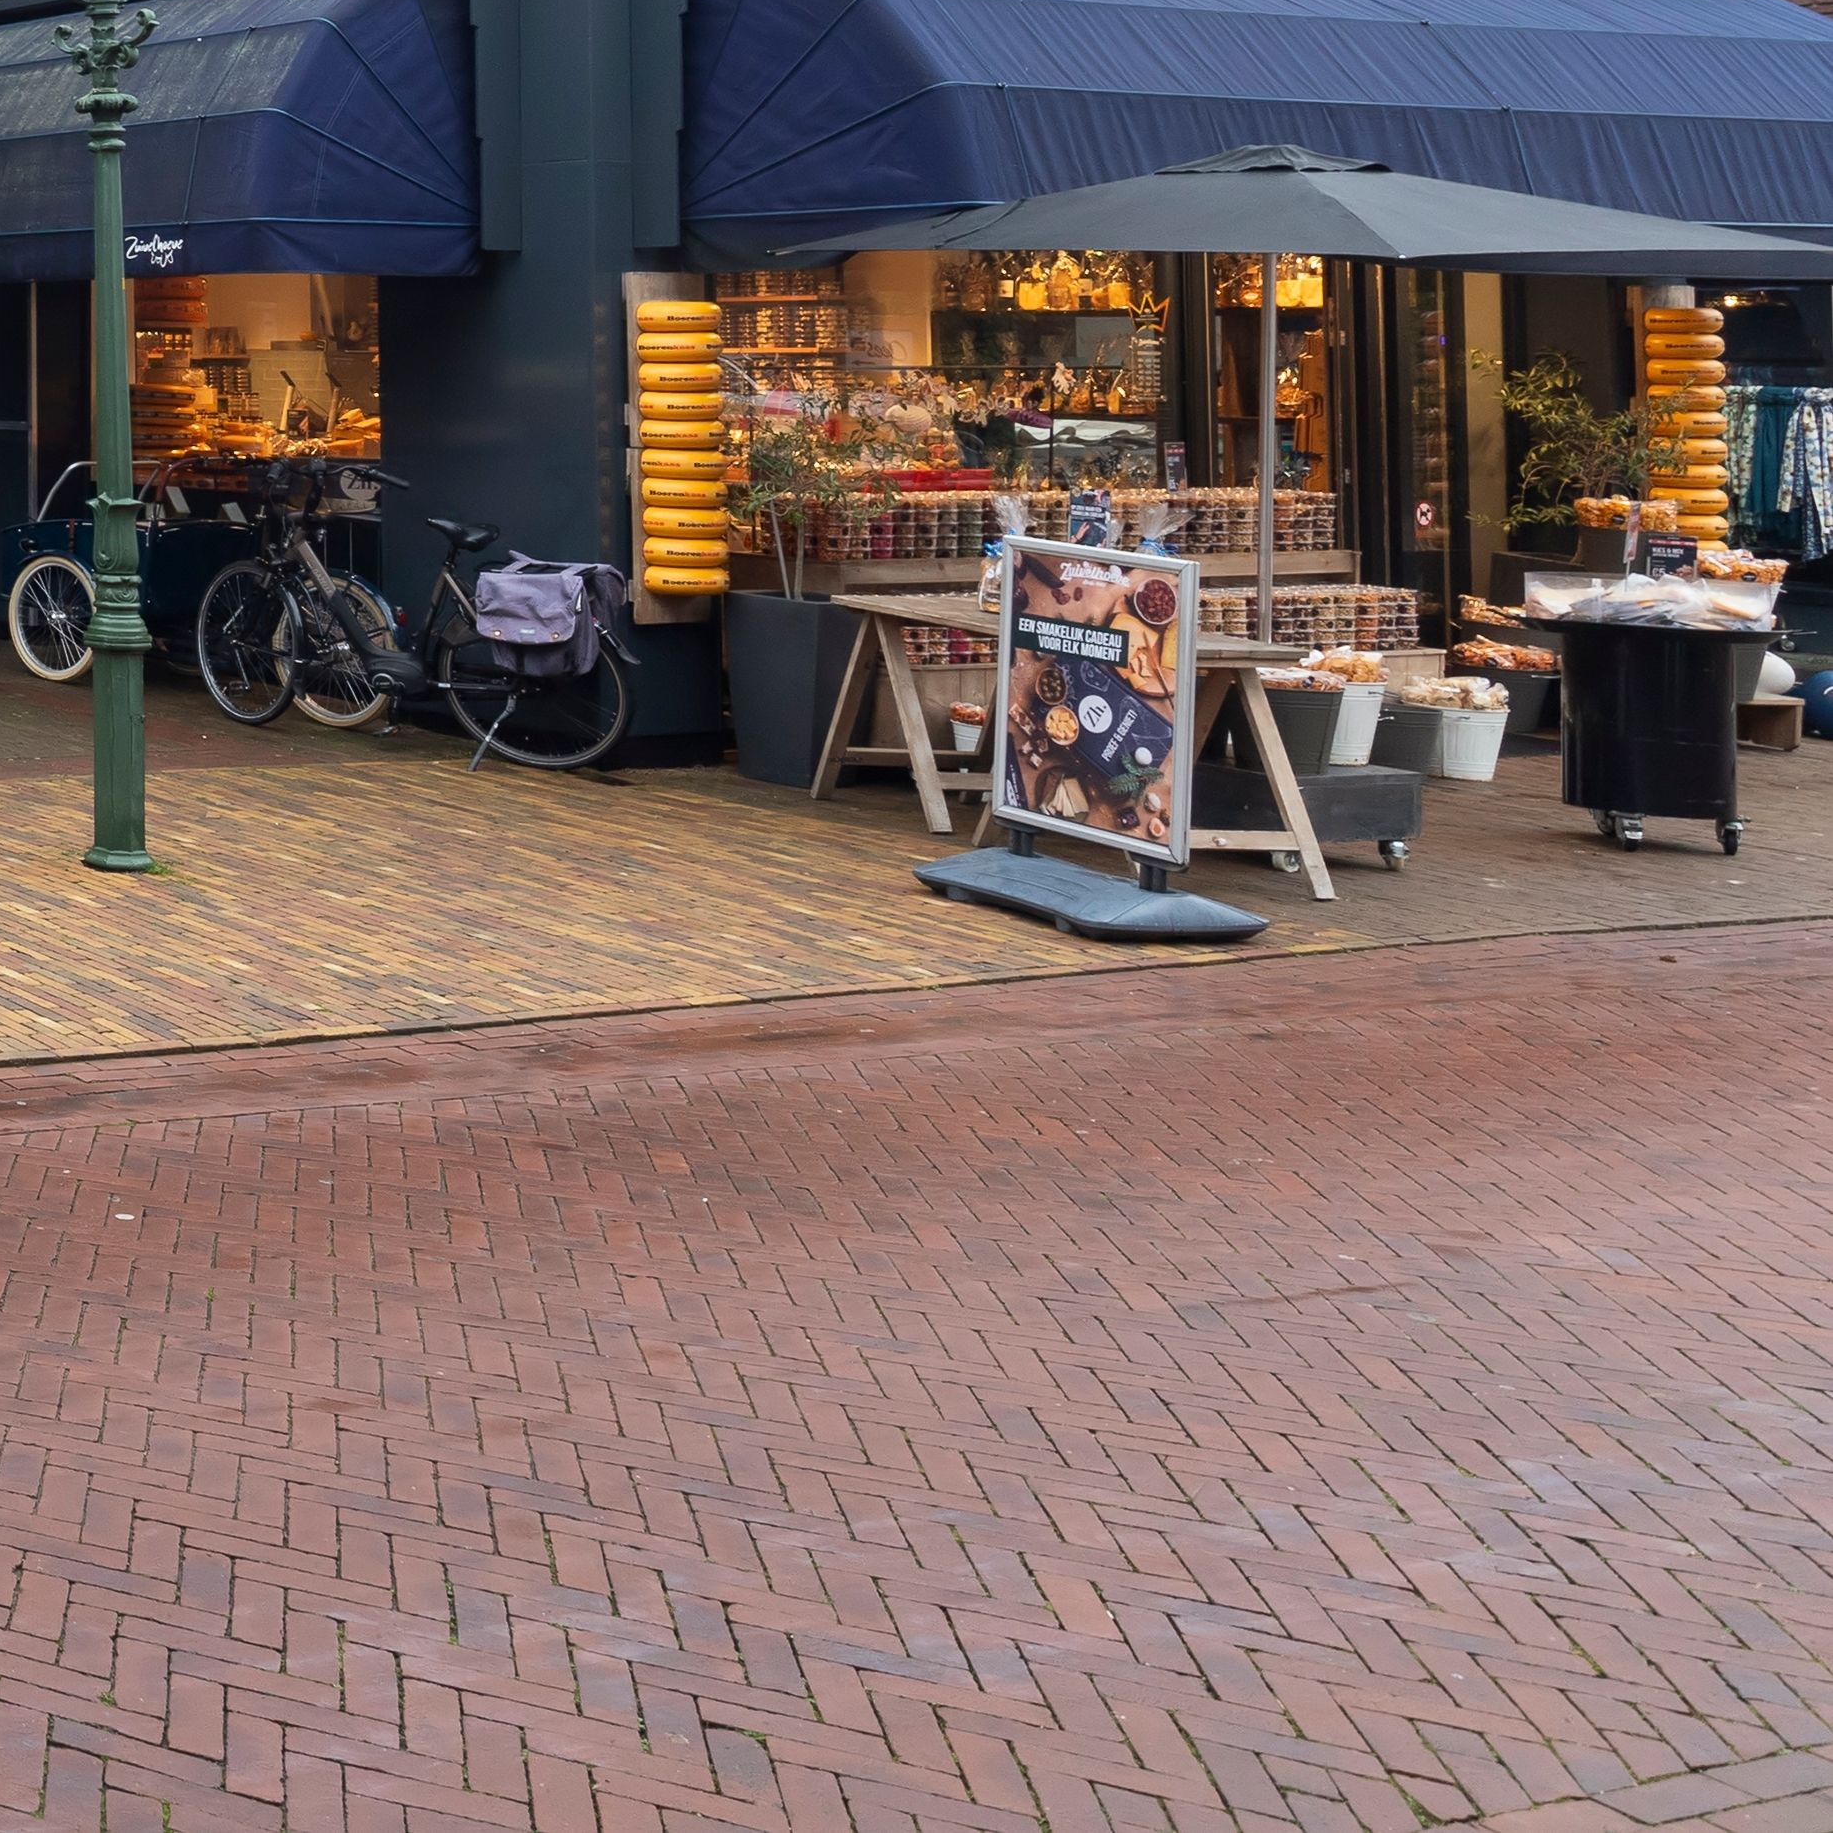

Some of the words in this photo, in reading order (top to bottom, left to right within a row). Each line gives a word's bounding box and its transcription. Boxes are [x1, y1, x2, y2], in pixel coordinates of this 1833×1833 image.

[1018, 617, 1036, 633] EEN
[1035, 621, 1085, 642] SMAKELIJK
[1085, 630, 1123, 648] CADEAU
[1038, 635, 1062, 652] VOOR
[1062, 639, 1081, 655] ELK
[1080, 643, 1123, 662] MOMENT
